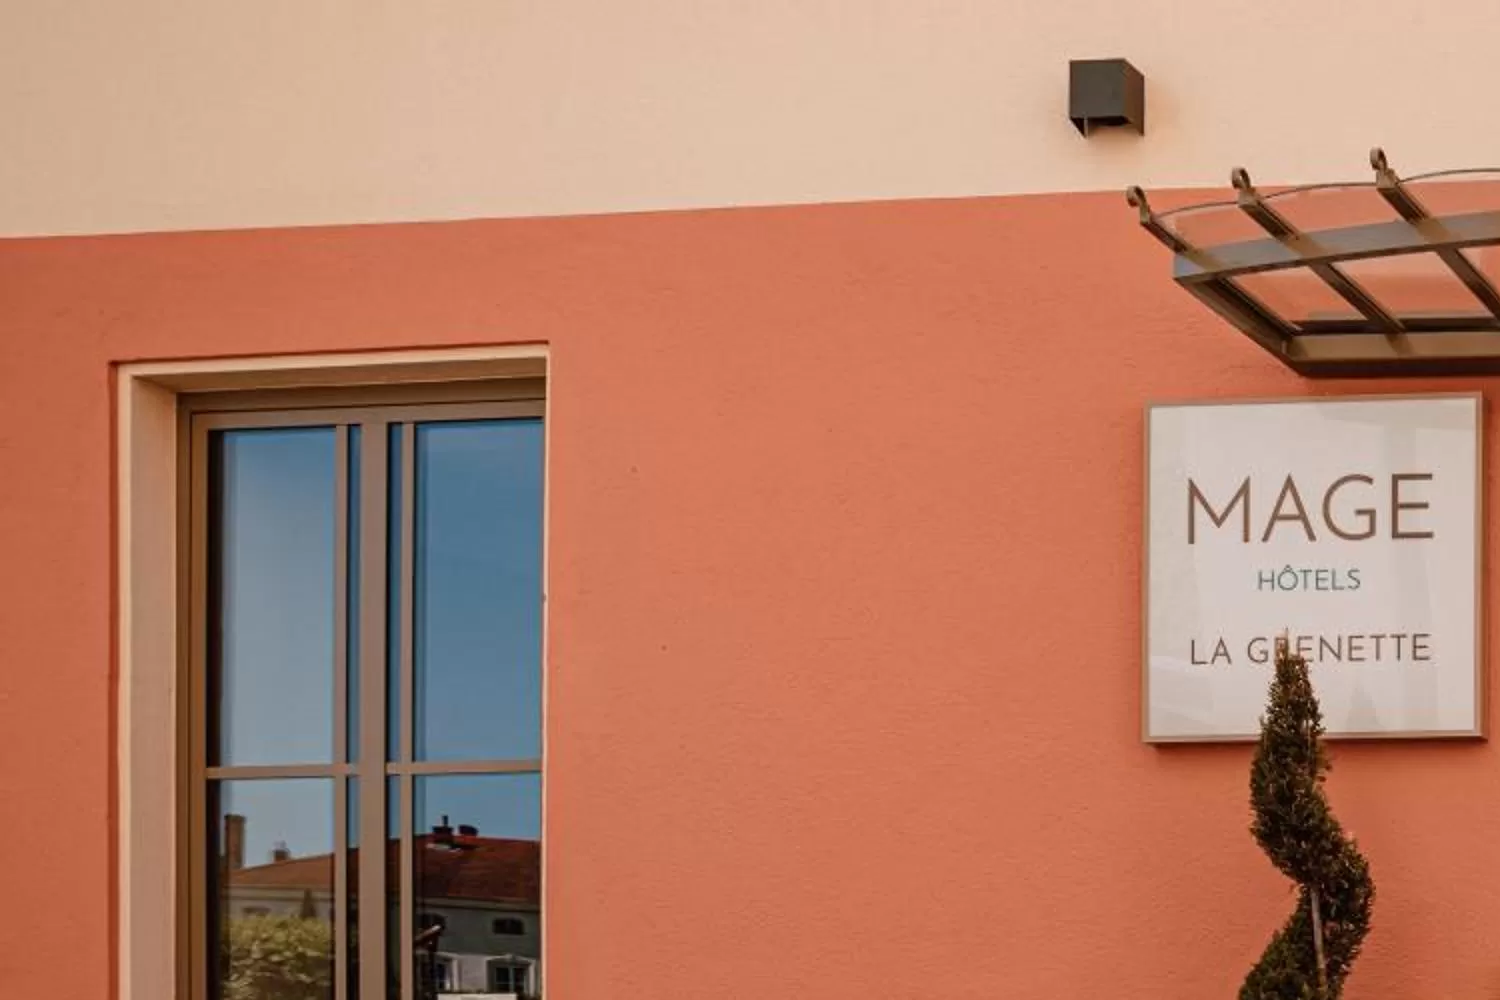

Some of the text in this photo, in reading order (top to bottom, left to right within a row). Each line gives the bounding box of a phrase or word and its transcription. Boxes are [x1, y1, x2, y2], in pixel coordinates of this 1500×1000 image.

[1187, 473, 1435, 545] MAGE
[1257, 564, 1362, 592] HÔTELS
[1190, 636, 1232, 665] LA
